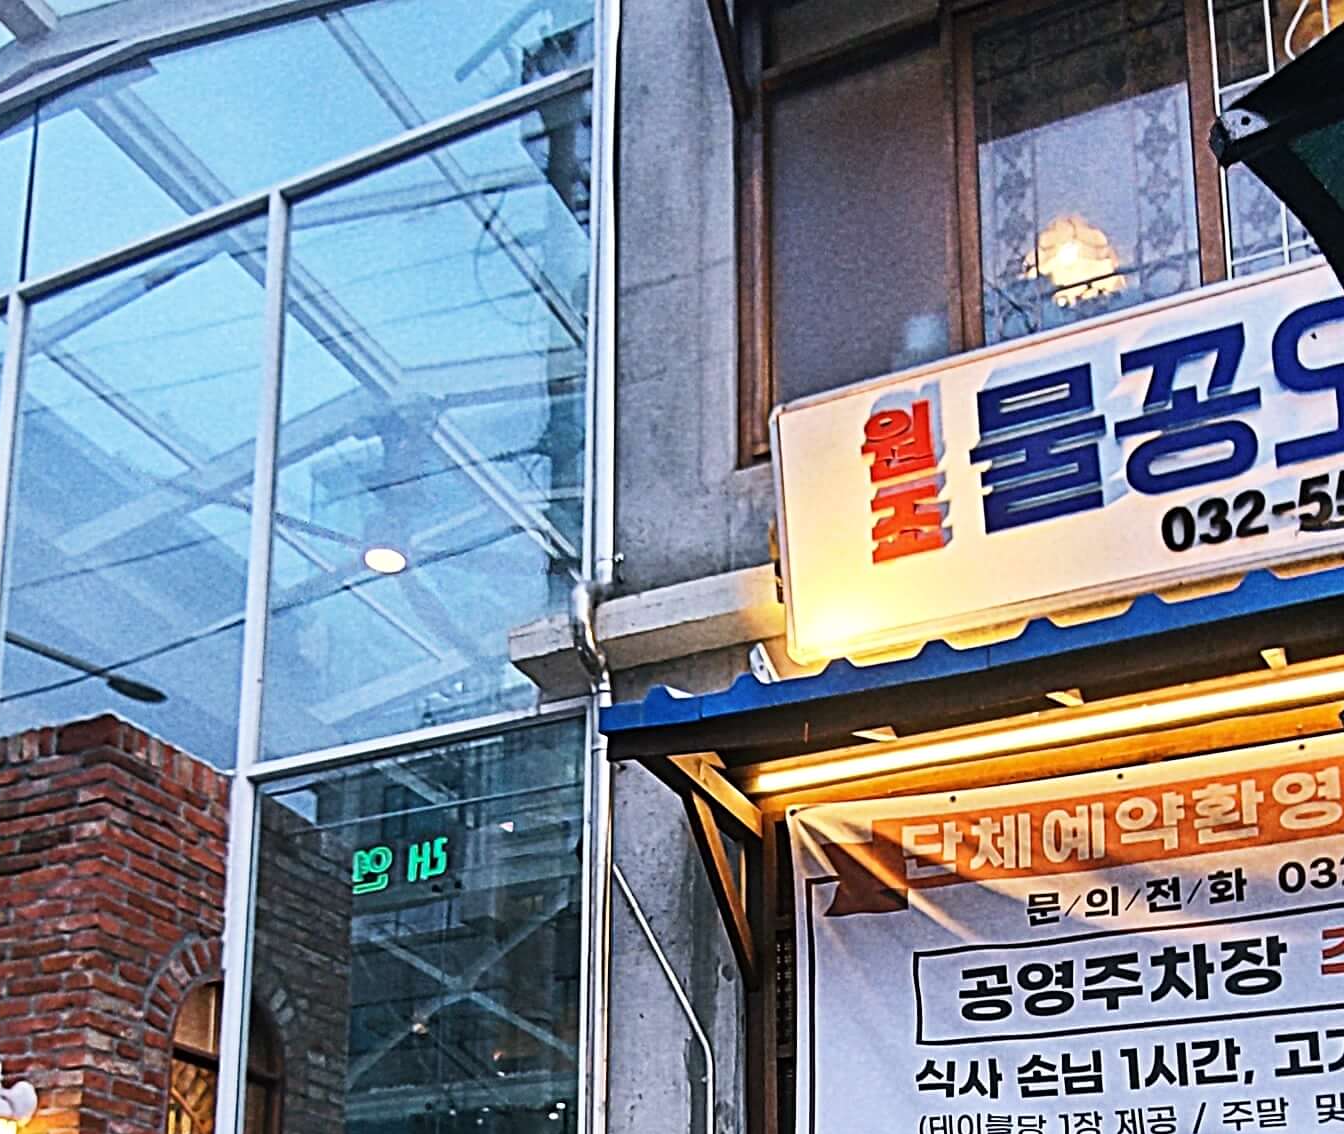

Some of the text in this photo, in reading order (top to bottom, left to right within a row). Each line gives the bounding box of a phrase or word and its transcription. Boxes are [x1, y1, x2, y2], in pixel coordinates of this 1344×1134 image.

[861, 399, 947, 564] 원조
[899, 766, 1344, 880] 단체예약환영
[1026, 867, 1248, 926] 문/의/전/화
[958, 935, 1288, 1022] 공영주차장
[915, 1057, 1004, 1099] 식사
[1017, 1049, 1104, 1098] 손님
[1119, 1037, 1255, 1090] 1시간,
[1193, 1101, 1206, 1134] /
[1221, 1097, 1290, 1131] 주말
